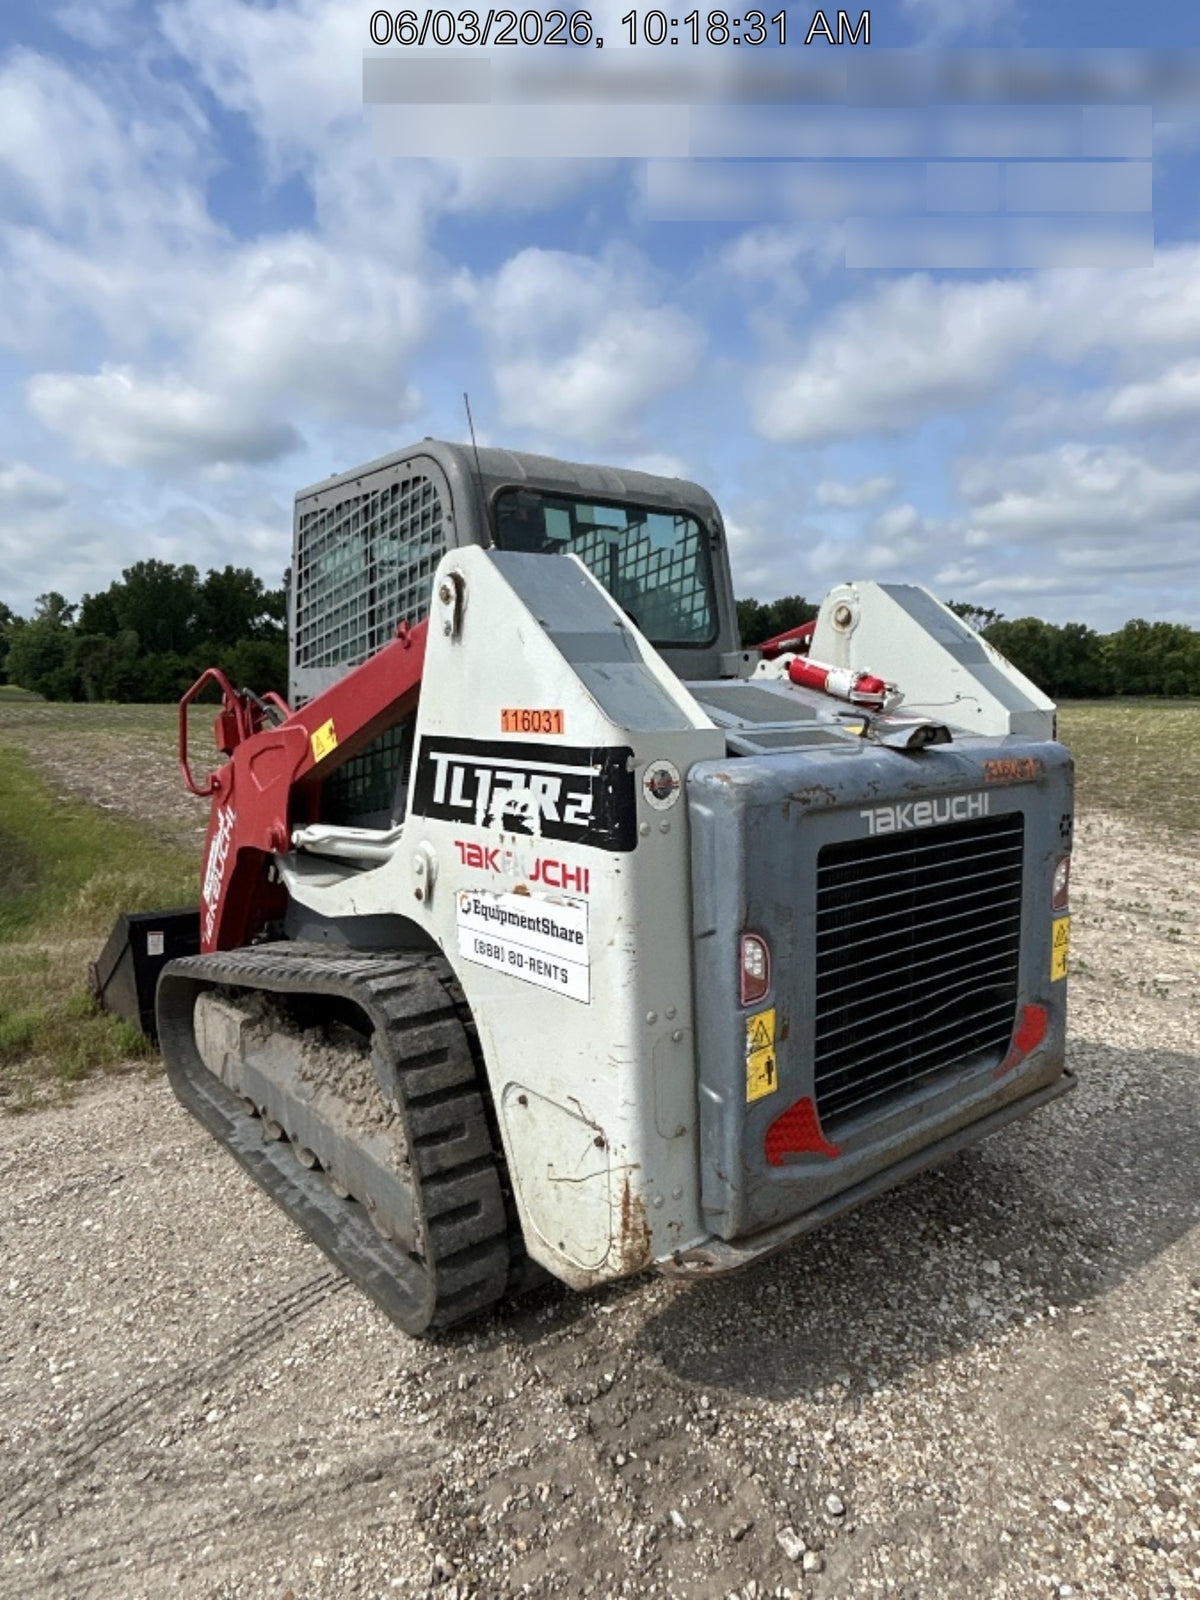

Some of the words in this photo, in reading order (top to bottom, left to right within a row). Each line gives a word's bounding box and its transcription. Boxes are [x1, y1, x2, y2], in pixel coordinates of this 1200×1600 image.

[501, 709, 561, 733] 116031
[859, 792, 989, 835] TAKEUCHI
[454, 840, 589, 894] TAKUCHI
[472, 898, 584, 945] EquipmentShare
[508, 950, 568, 984] 80-RENTS
